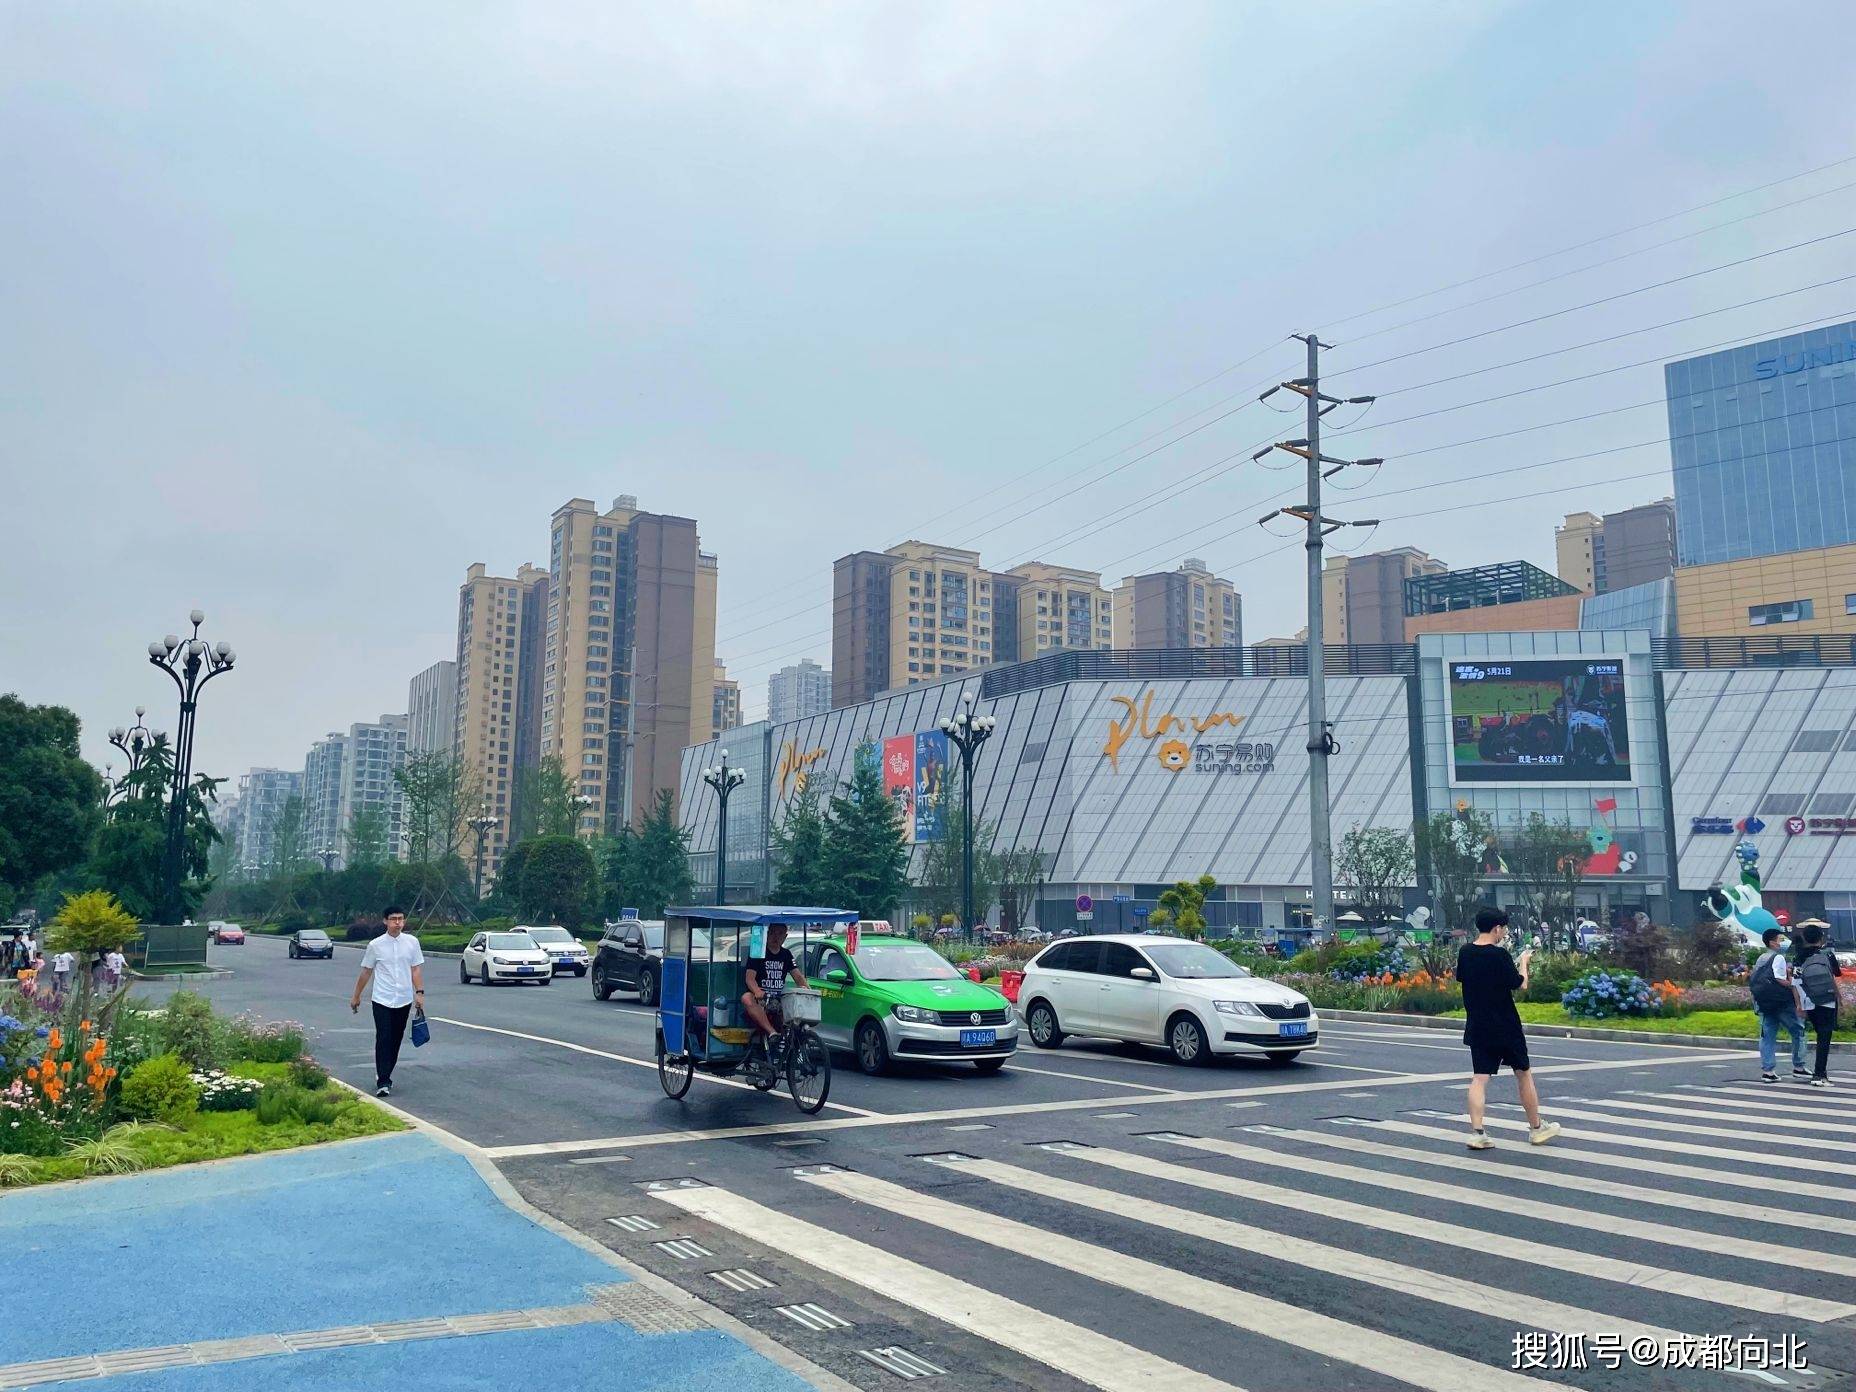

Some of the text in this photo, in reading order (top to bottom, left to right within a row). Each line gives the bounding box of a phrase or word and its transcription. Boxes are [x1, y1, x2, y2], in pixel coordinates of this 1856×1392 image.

[1196, 743, 1273, 762] 苏宁易购
[1195, 763, 1274, 775] suning.com
[765, 960, 784, 970] SHOW
[766, 970, 783, 980] YOUR
